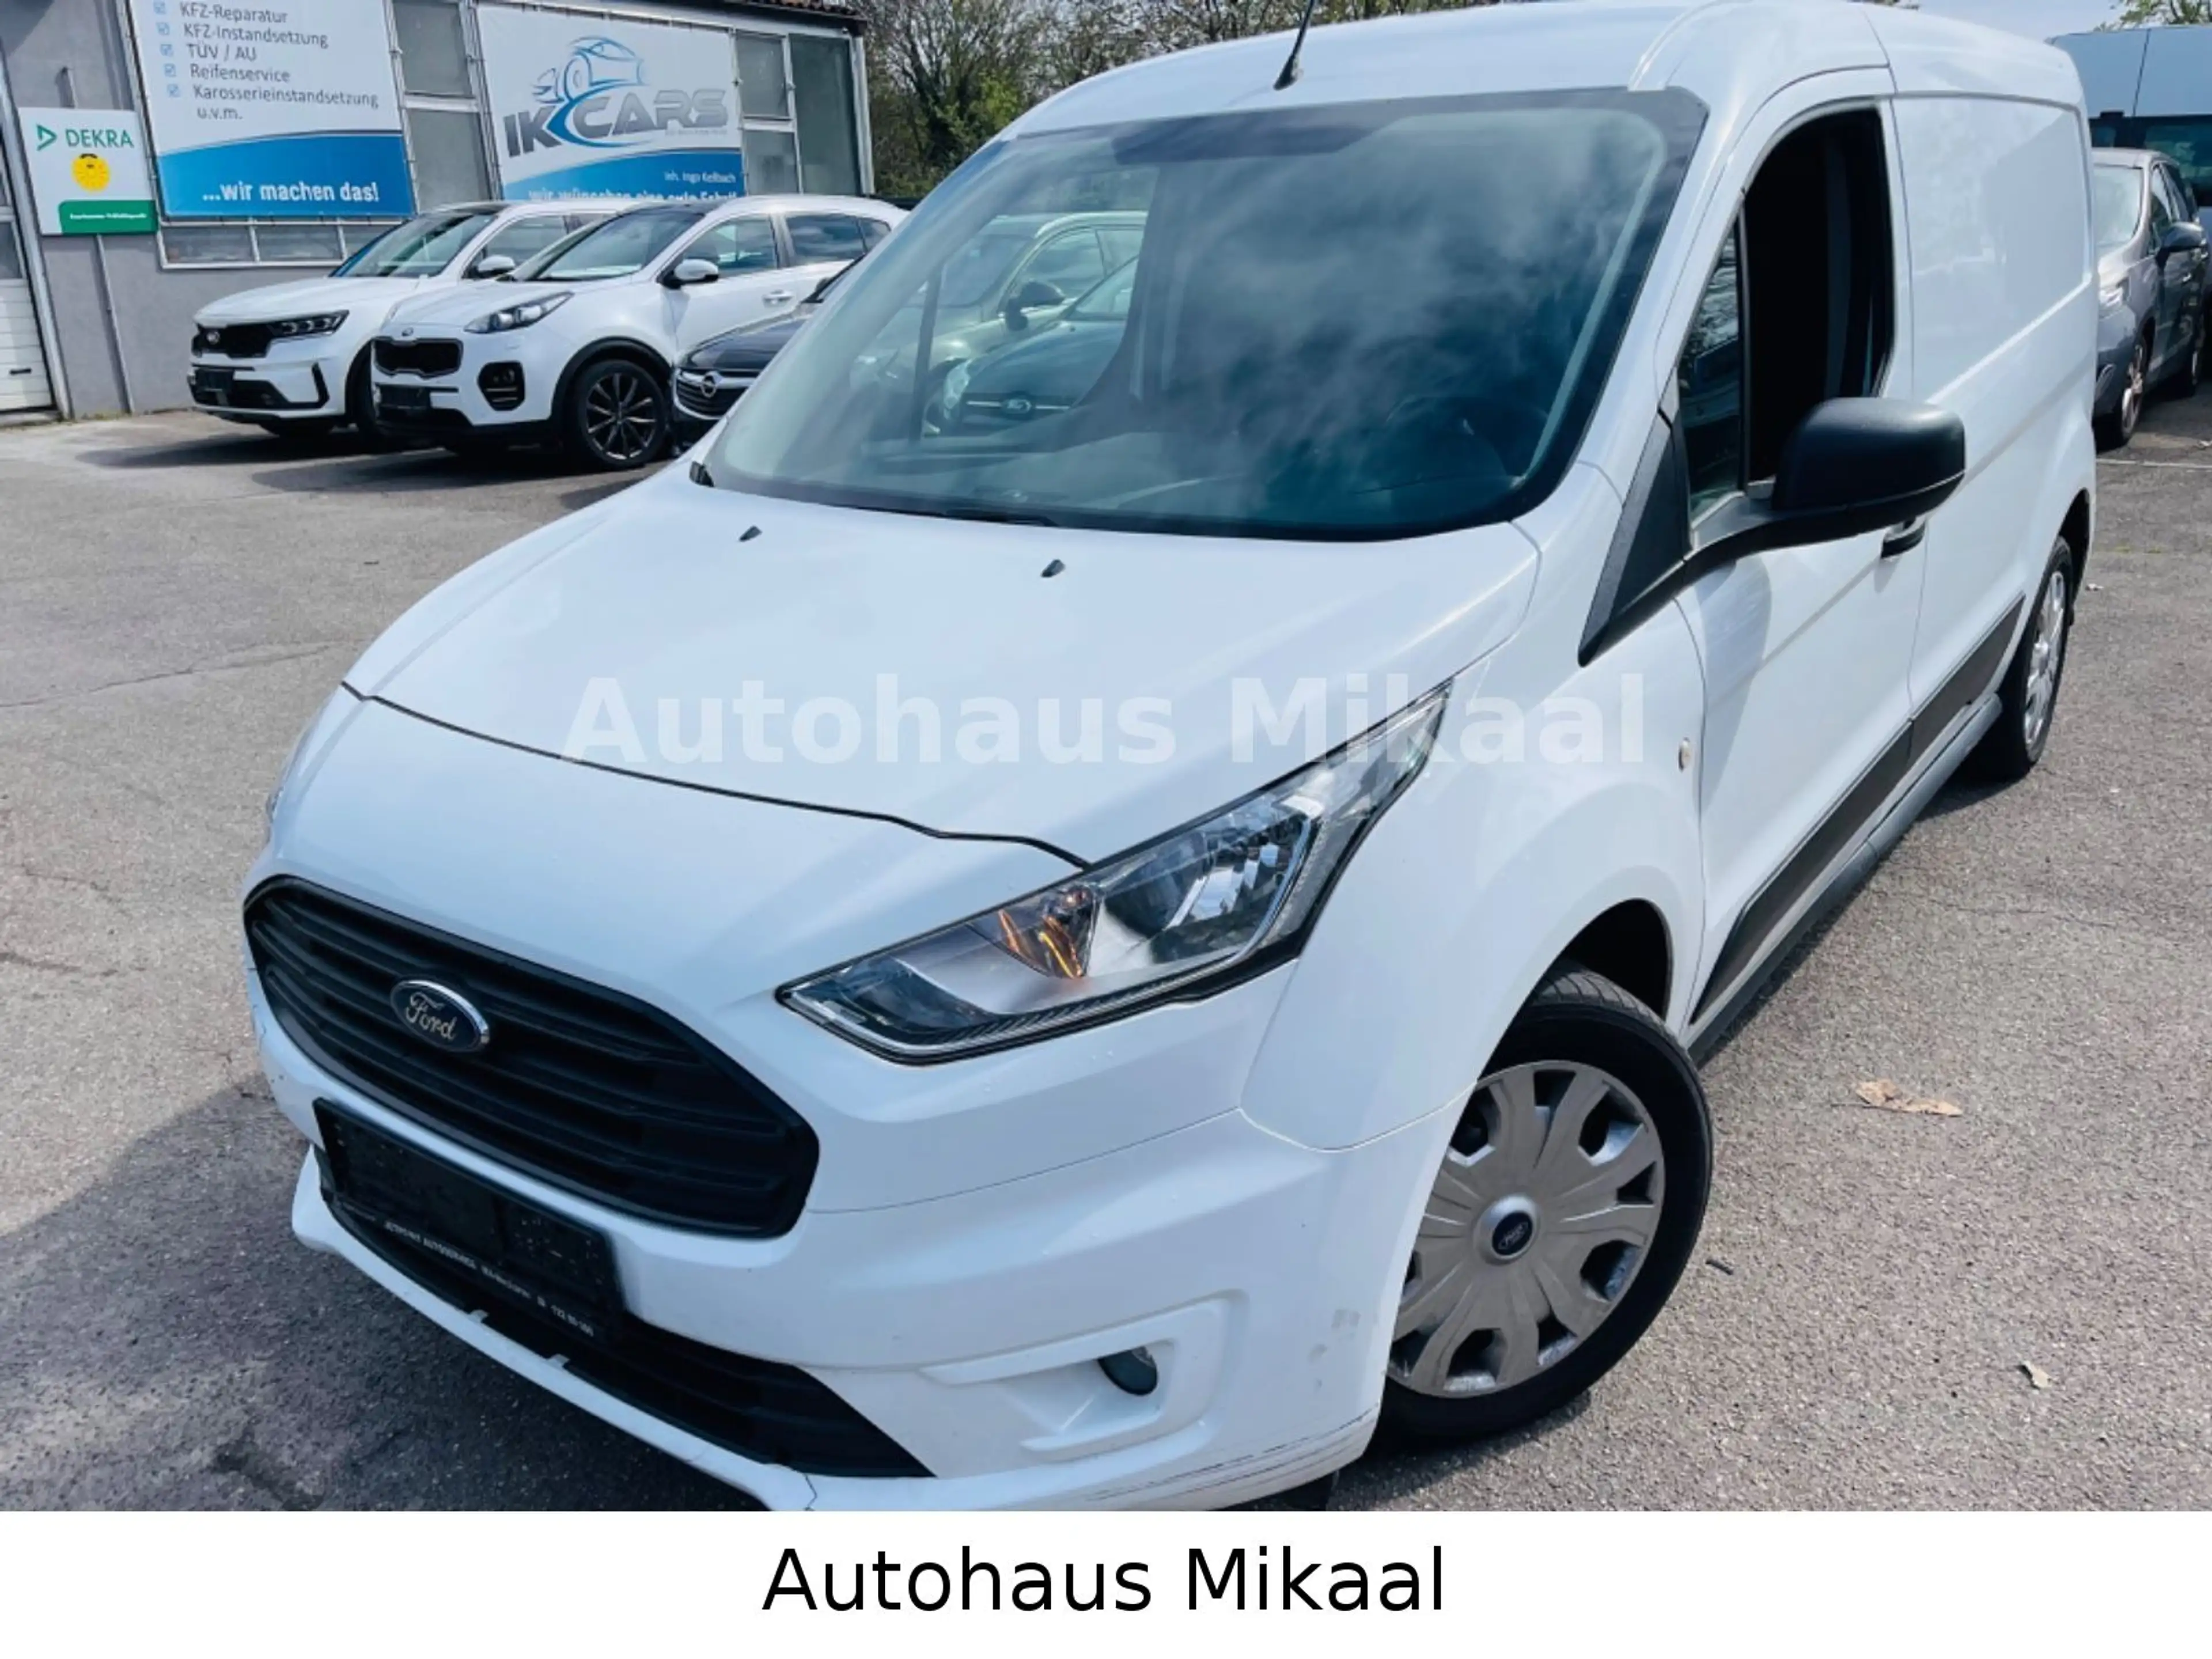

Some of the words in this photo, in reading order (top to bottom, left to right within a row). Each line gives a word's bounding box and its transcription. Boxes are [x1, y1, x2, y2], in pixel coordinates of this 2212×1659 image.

[179, 2, 288, 24] KFZ-Reparatur
[183, 23, 329, 49] KFZ-Instandsetzung
[187, 41, 219, 59] TÜV
[234, 47, 257, 61] AU
[190, 64, 291, 82] Reifenservice
[193, 85, 379, 109] Karosserieinstandsetzung
[197, 108, 244, 120] u.v.m.
[573, 88, 728, 140] CARS
[65, 128, 135, 149] DEKRA
[259, 181, 335, 201] machen
[339, 181, 379, 202] das!
[406, 991, 457, 1041] Ford
